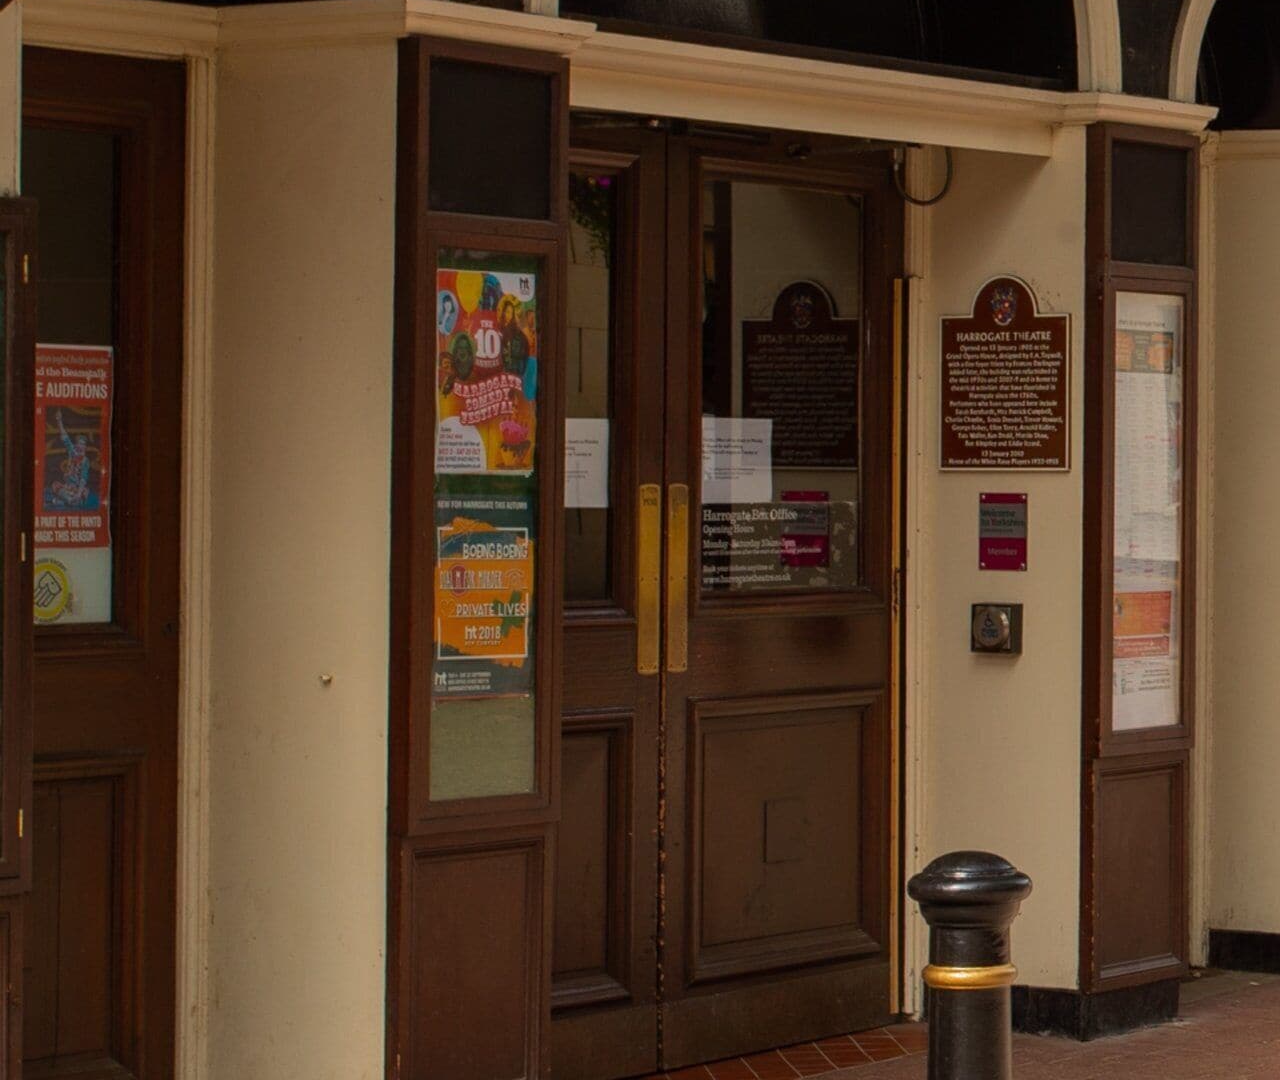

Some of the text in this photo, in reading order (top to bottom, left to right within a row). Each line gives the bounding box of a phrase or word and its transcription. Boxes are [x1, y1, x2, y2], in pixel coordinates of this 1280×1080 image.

[956, 331, 1052, 342] HARROGATE THEATRE
[46, 382, 108, 399] AUDITIONS
[703, 509, 752, 524] Harrogate
[770, 509, 797, 521] Office
[456, 602, 527, 617] PRIVATE LIVES
[479, 625, 501, 640] 2018
